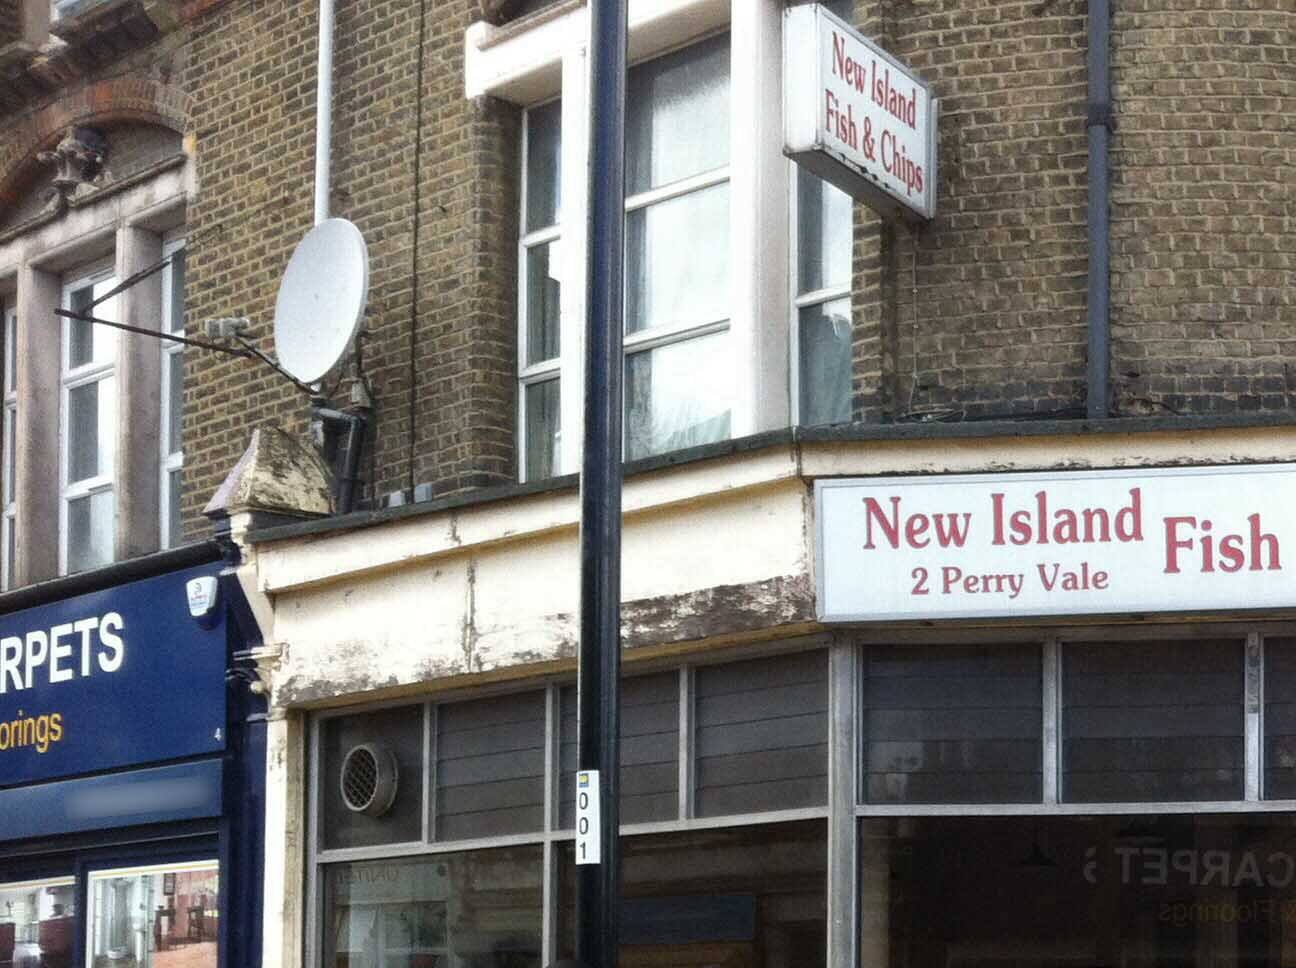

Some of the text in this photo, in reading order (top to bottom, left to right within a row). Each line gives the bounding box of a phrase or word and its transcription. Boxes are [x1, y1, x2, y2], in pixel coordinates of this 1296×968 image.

[832, 31, 916, 130] New Island
[825, 88, 923, 196] Fish & Chips
[862, 495, 972, 550] New
[991, 487, 1144, 547] Island
[1162, 512, 1282, 575] Fish
[910, 562, 1110, 599] 2 Perry Vale
[0, 611, 125, 694] RPETS
[0, 709, 64, 754] orings
